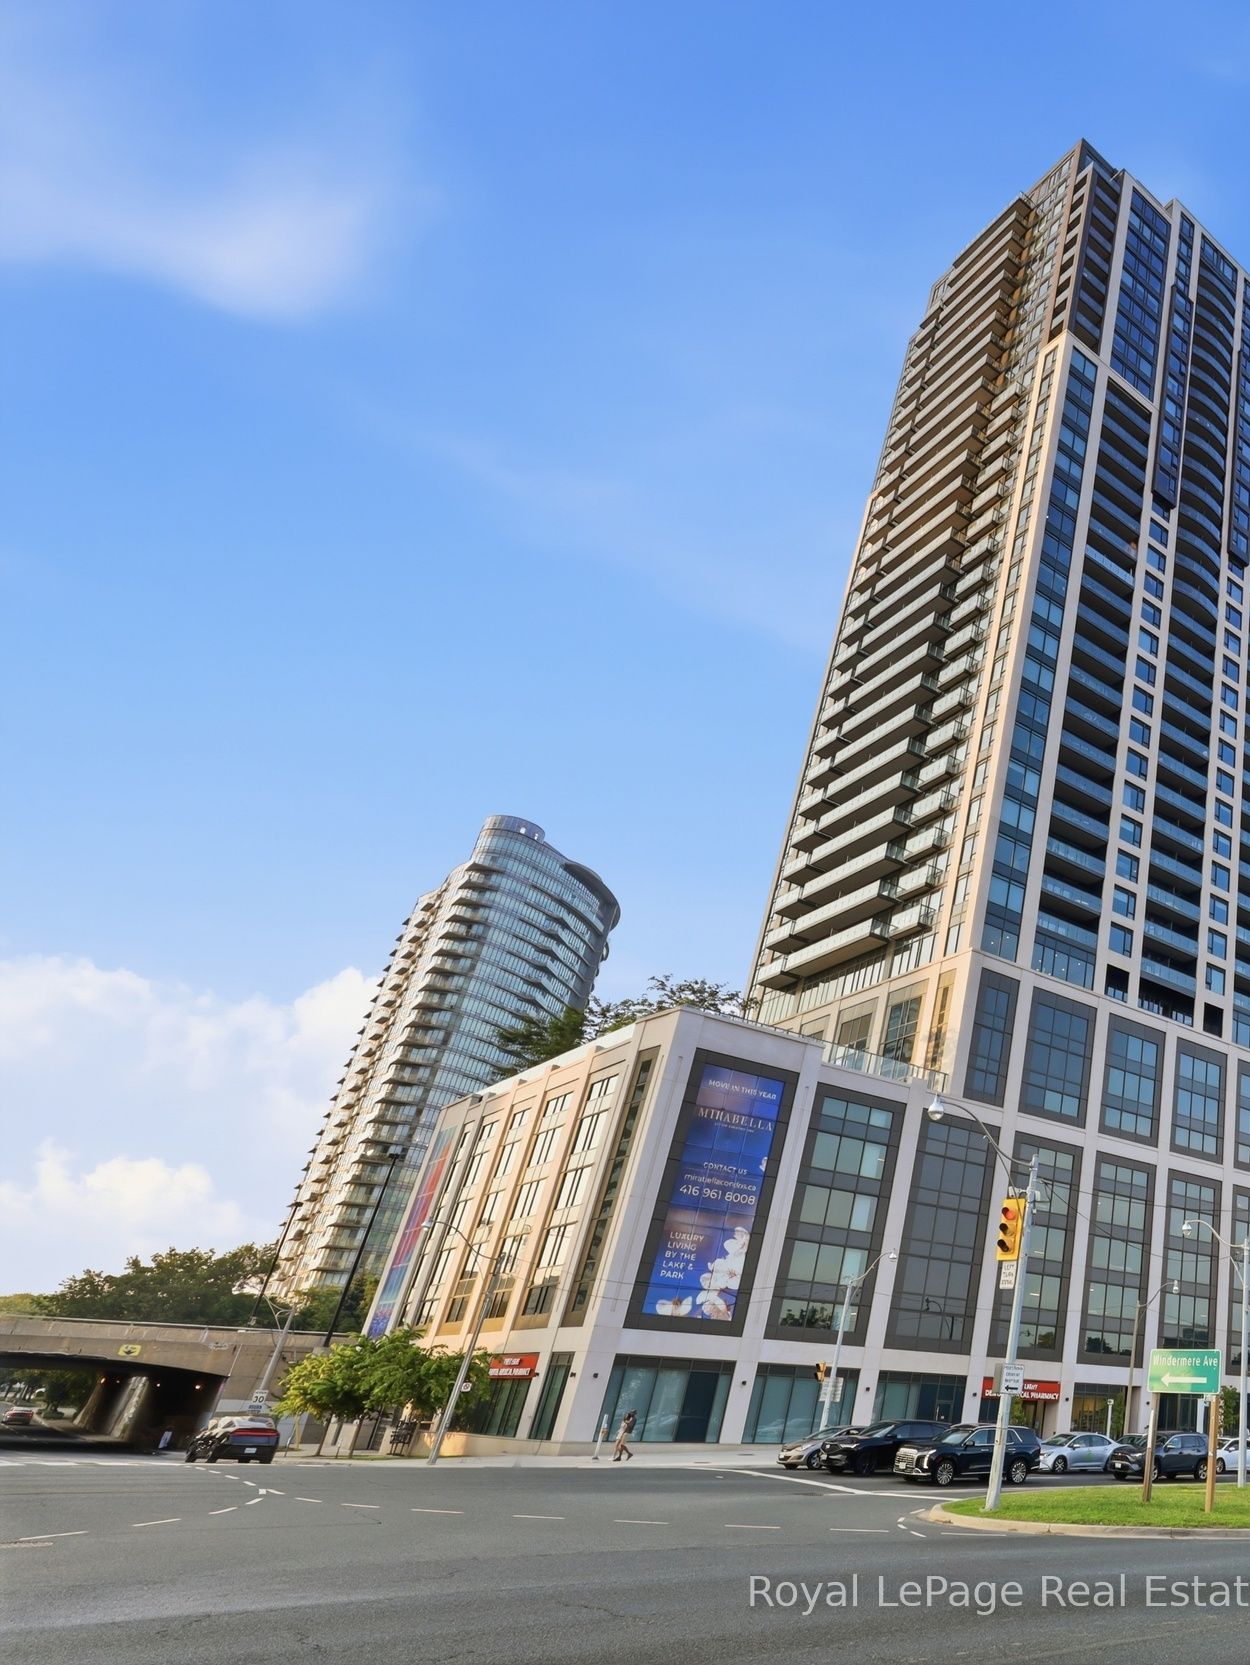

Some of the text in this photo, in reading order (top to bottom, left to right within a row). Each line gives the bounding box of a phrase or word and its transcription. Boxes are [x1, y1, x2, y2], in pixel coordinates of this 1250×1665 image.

[708, 1080, 730, 1090] MOVE
[742, 1087, 757, 1096] THIS
[759, 1091, 777, 1100] YEAR
[698, 1107, 772, 1132] MIRABELLA
[703, 1161, 737, 1173] CONTACT
[684, 1173, 757, 1192] mirabellacondos.ca
[680, 1184, 756, 1205] 416 961 8008
[670, 1231, 704, 1242] LUXURY
[667, 1241, 697, 1251] LIVING
[665, 1250, 696, 1261] BY THE
[662, 1260, 686, 1269] LAKE
[660, 1270, 684, 1280] PARK
[1153, 1355, 1218, 1367] Windermere Ave
[1031, 1392, 1059, 1400] PHARMACY
